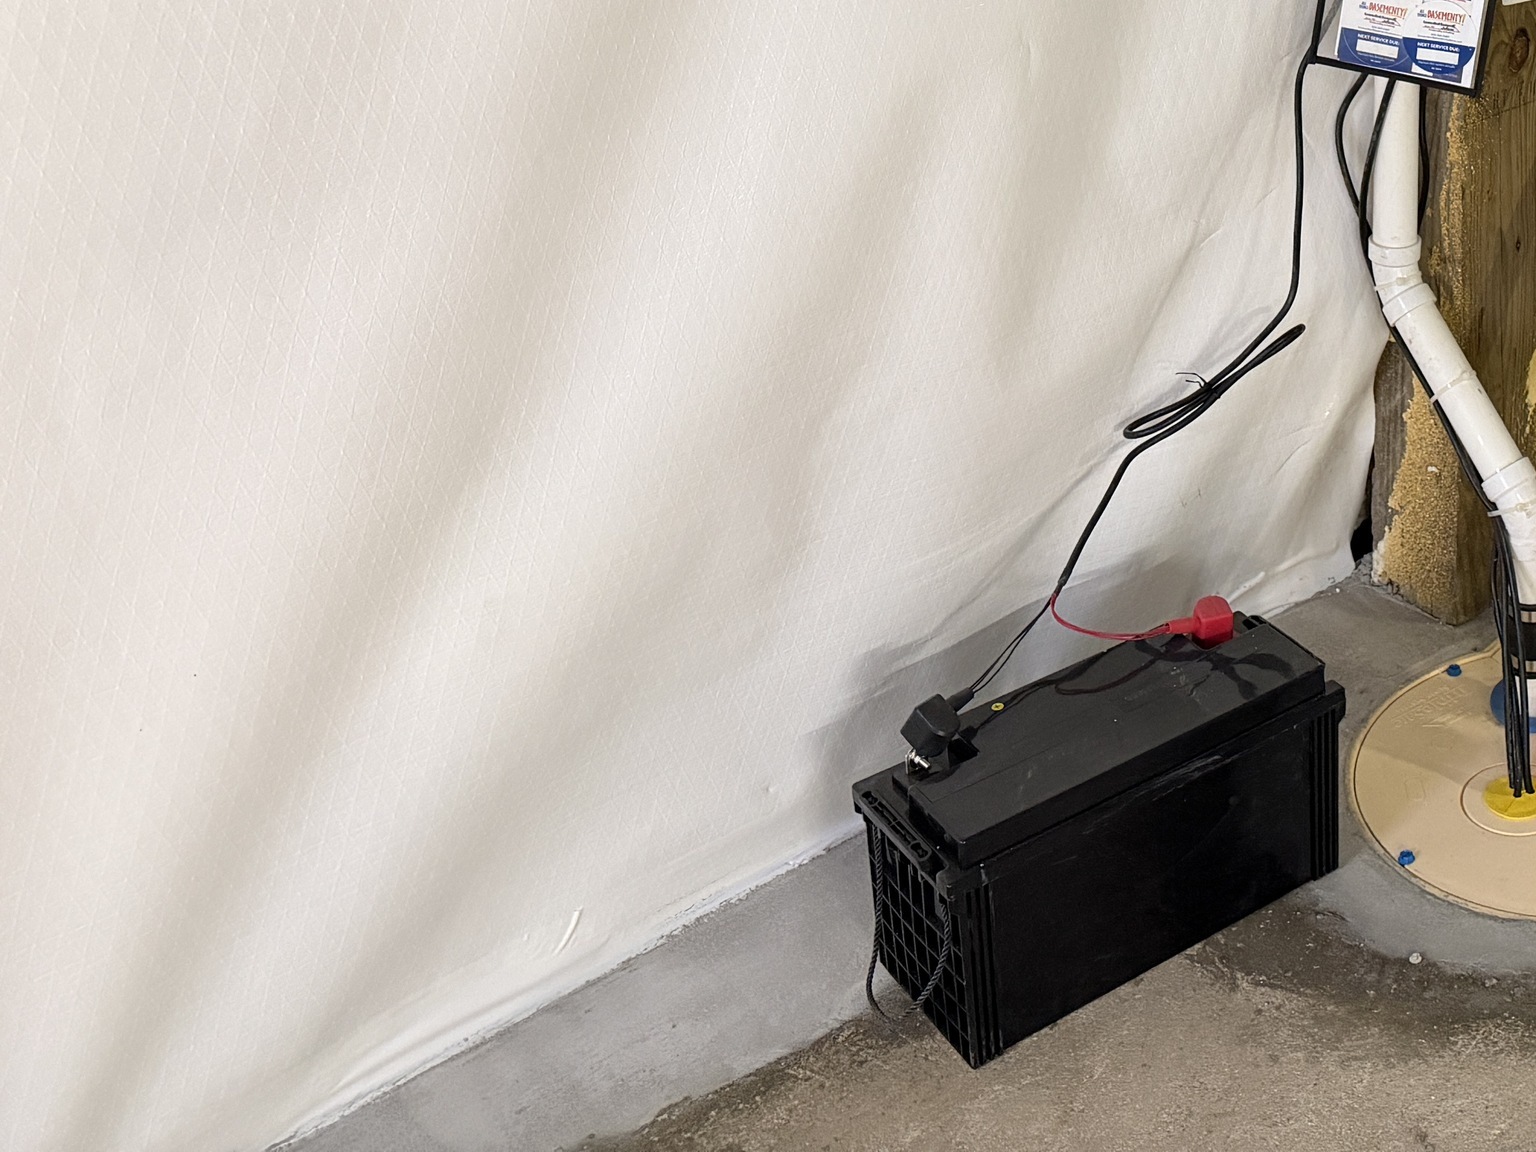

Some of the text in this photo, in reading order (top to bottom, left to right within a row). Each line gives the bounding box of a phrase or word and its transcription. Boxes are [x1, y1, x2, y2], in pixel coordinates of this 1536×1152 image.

[1368, 2, 1408, 20] BASEMENTY!
[1427, 10, 1466, 27] BASEMENTY!
[1370, 35, 1389, 43] SERVICE
